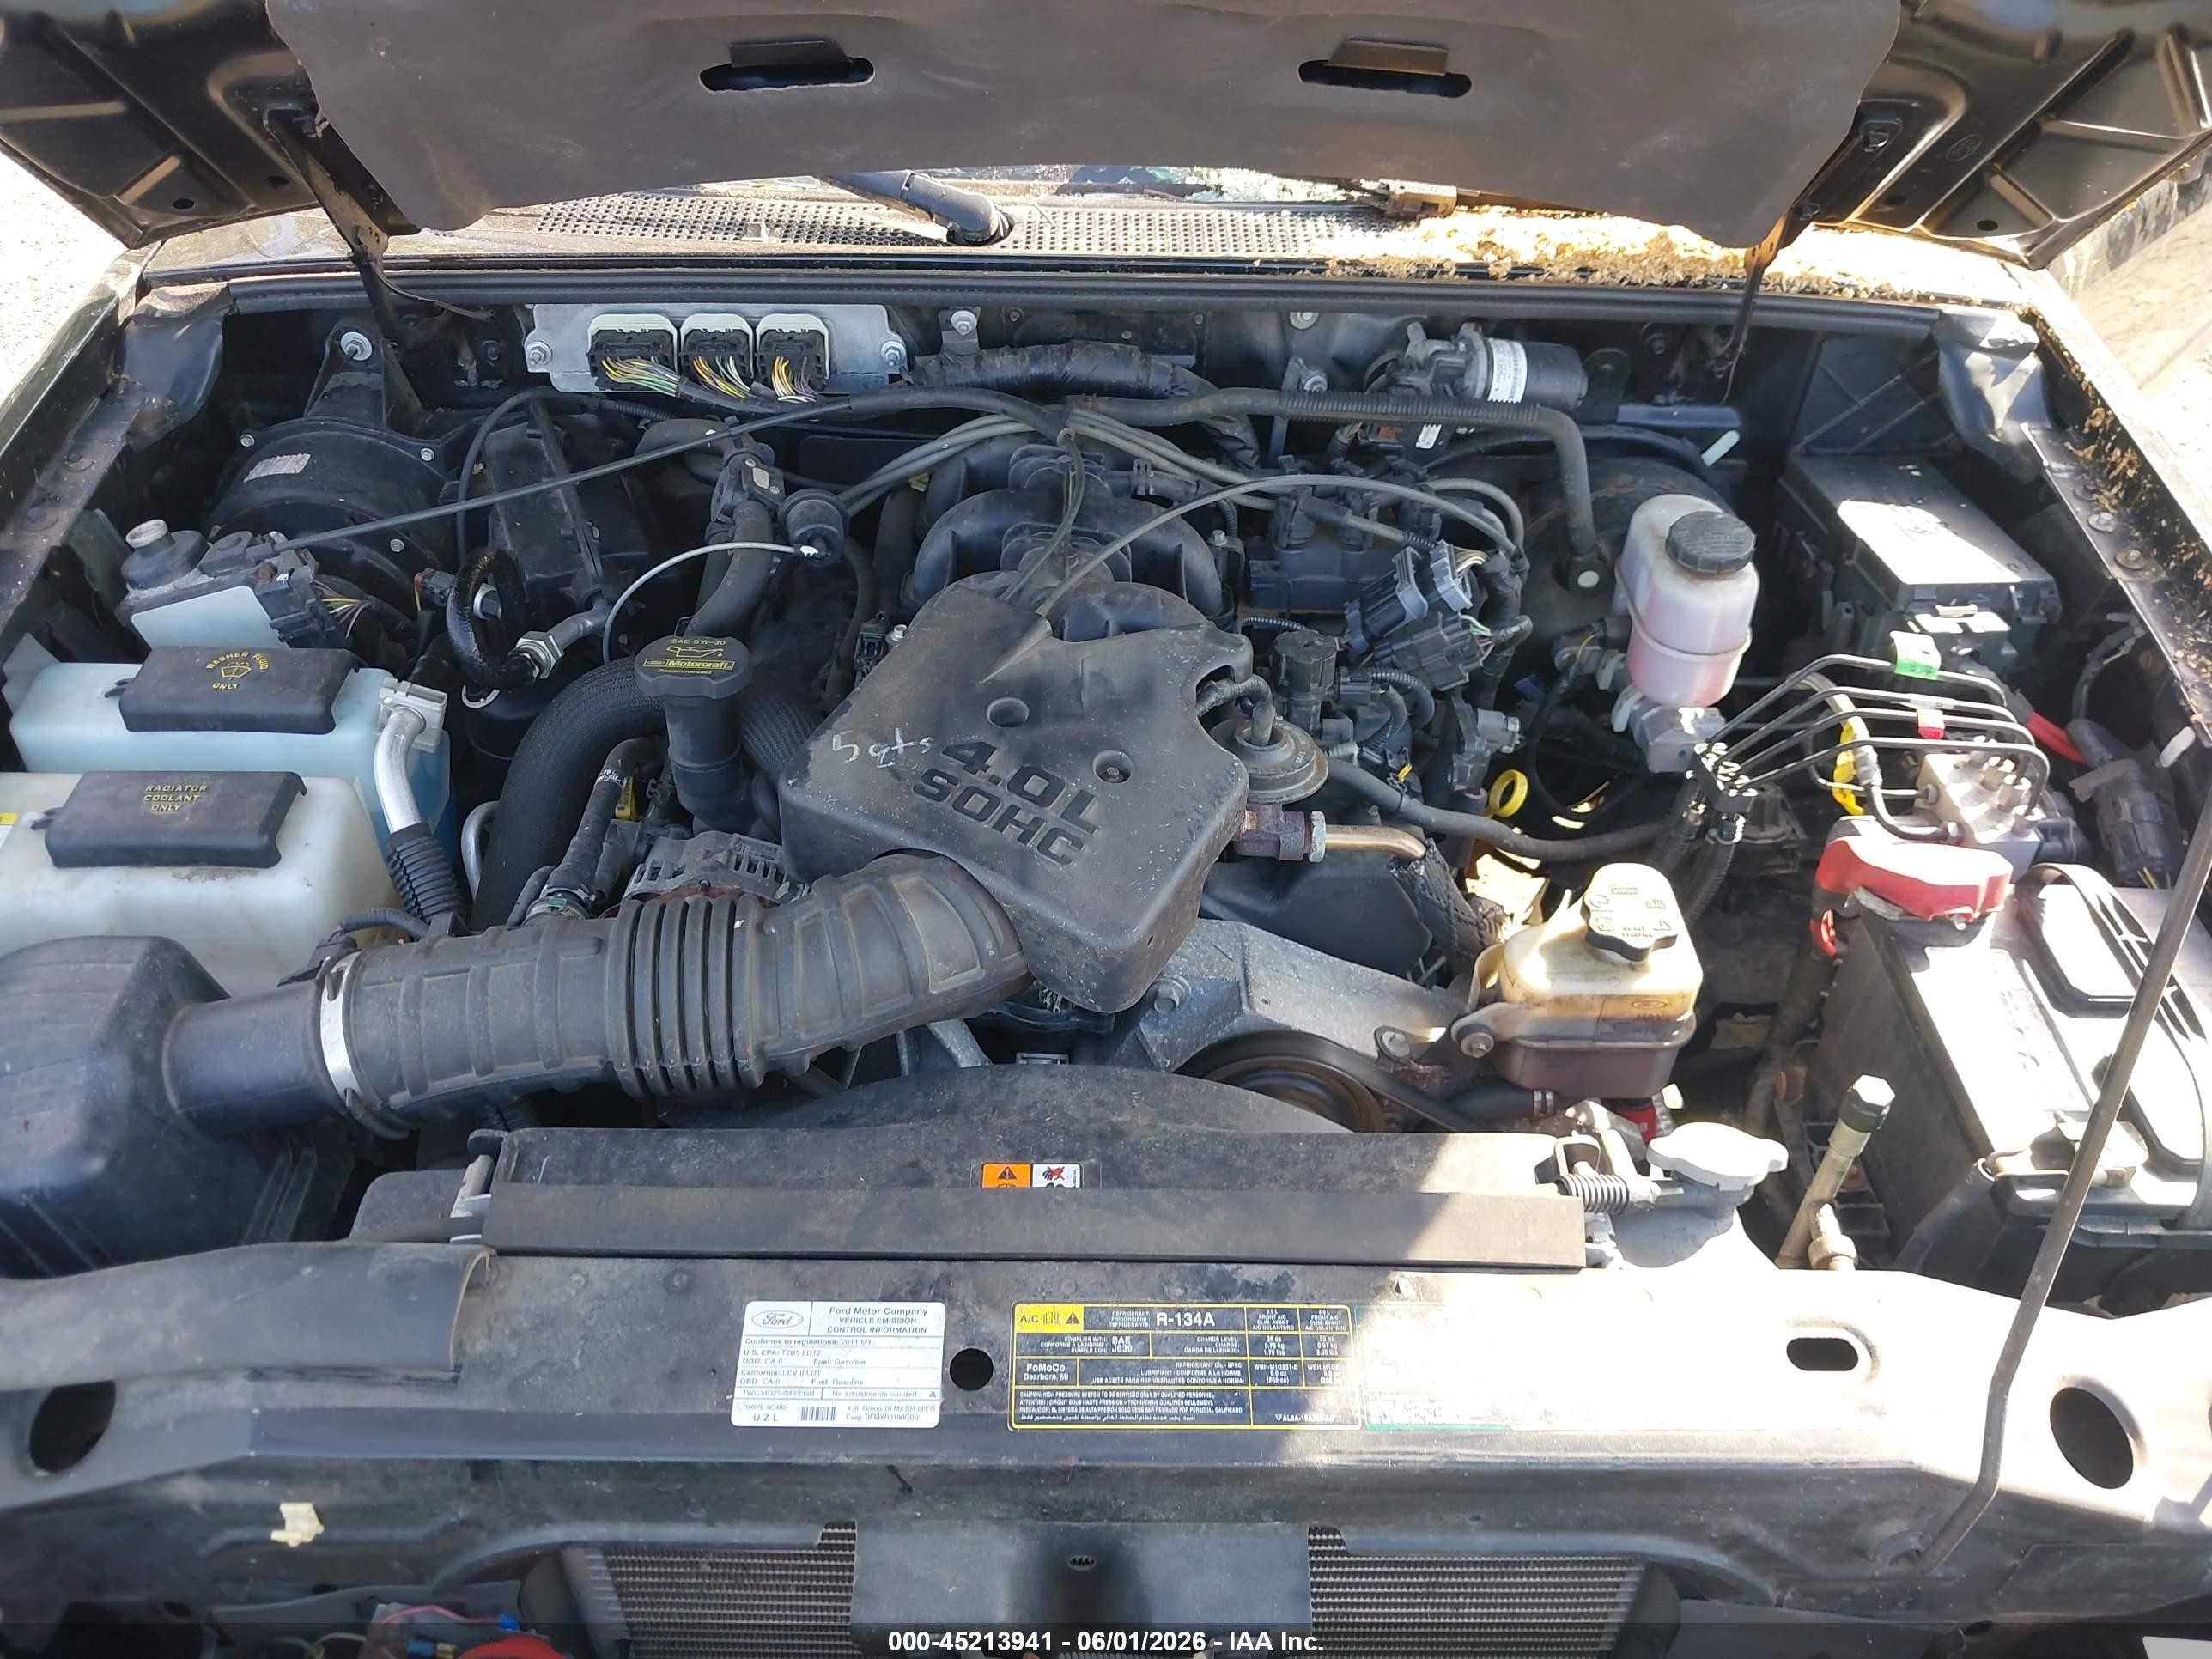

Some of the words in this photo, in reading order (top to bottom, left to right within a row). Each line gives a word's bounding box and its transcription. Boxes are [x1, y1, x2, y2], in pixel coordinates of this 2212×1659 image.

[668, 659, 730, 669] Motorcraft
[941, 740, 1099, 836] 4.0L
[912, 768, 1085, 866] SOHC
[829, 1306, 852, 1316] Ford
[854, 1306, 881, 1316] Motor
[884, 1306, 928, 1317] Company
[762, 1312, 793, 1326] Ford
[877, 1316, 917, 1325] EMISSION
[1019, 1313, 1039, 1324] A/C
[1155, 1310, 1217, 1328] R-134A
[744, 1337, 782, 1346] Conforms
[1026, 1362, 1066, 1373] FoMoCo
[1024, 1372, 1059, 1382] Dearborn,
[1060, 1372, 1069, 1381] MI
